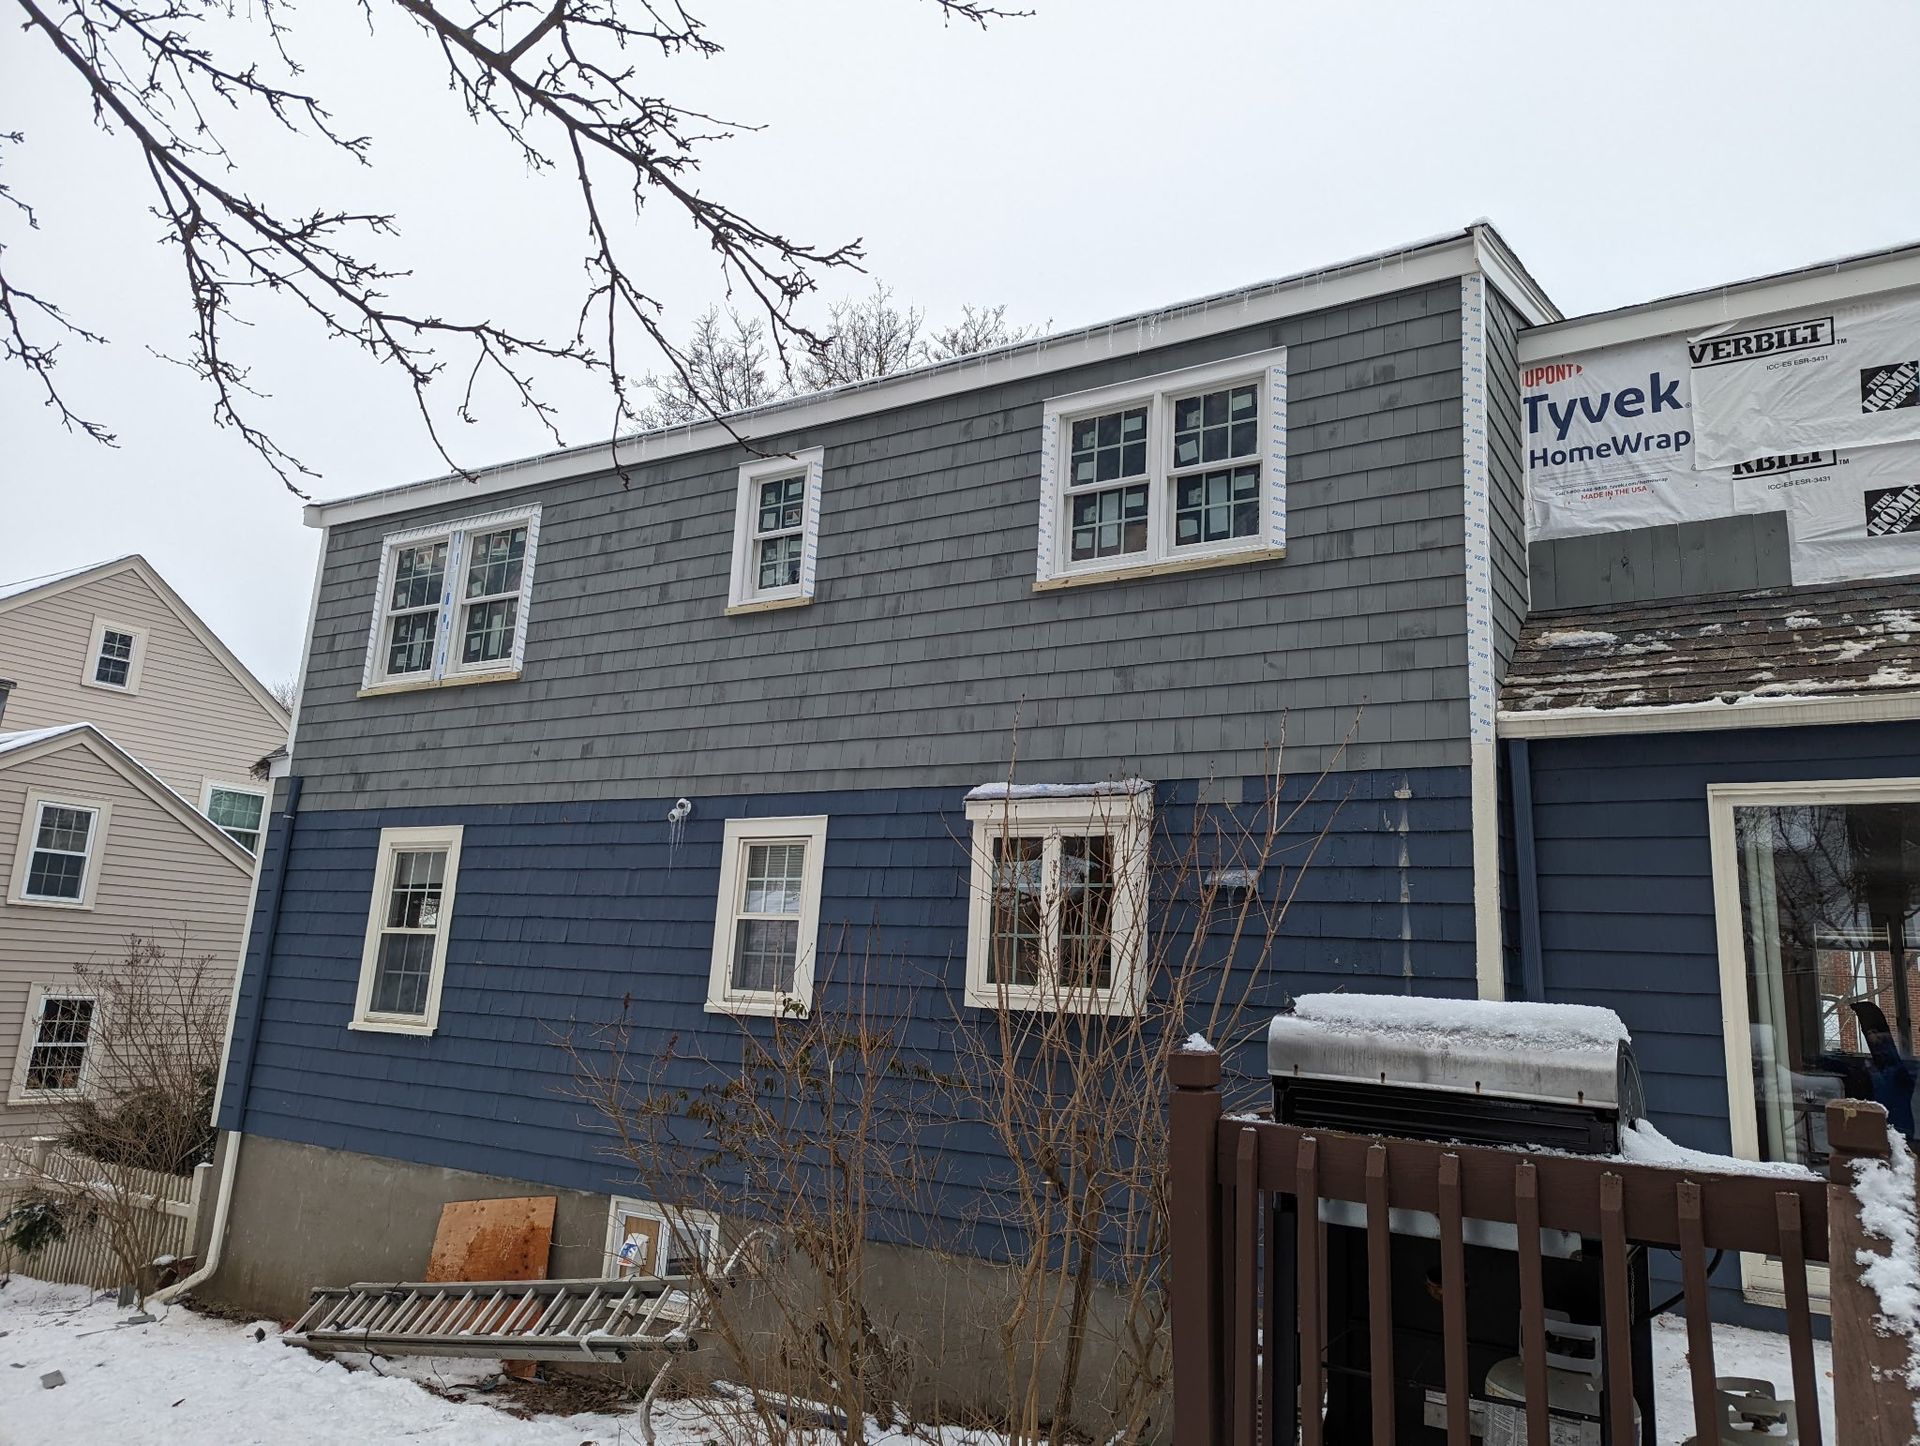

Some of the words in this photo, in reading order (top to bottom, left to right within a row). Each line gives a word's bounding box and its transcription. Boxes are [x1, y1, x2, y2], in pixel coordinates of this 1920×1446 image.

[1688, 323, 1825, 364] VERBILT
[1522, 364, 1574, 388] UPONT
[1862, 362, 1919, 412] HOME
[1866, 370, 1890, 390] THE
[1884, 377, 1919, 410] DEPOT
[1523, 372, 1684, 441] Tyvek
[1530, 430, 1692, 469] HomeWrap
[1581, 491, 1604, 501] MADE
[1605, 490, 1614, 498] IN
[1614, 488, 1630, 497] THE
[1631, 485, 1647, 494] USA
[1867, 485, 1920, 536] HOME
[1870, 492, 1896, 512] THE
